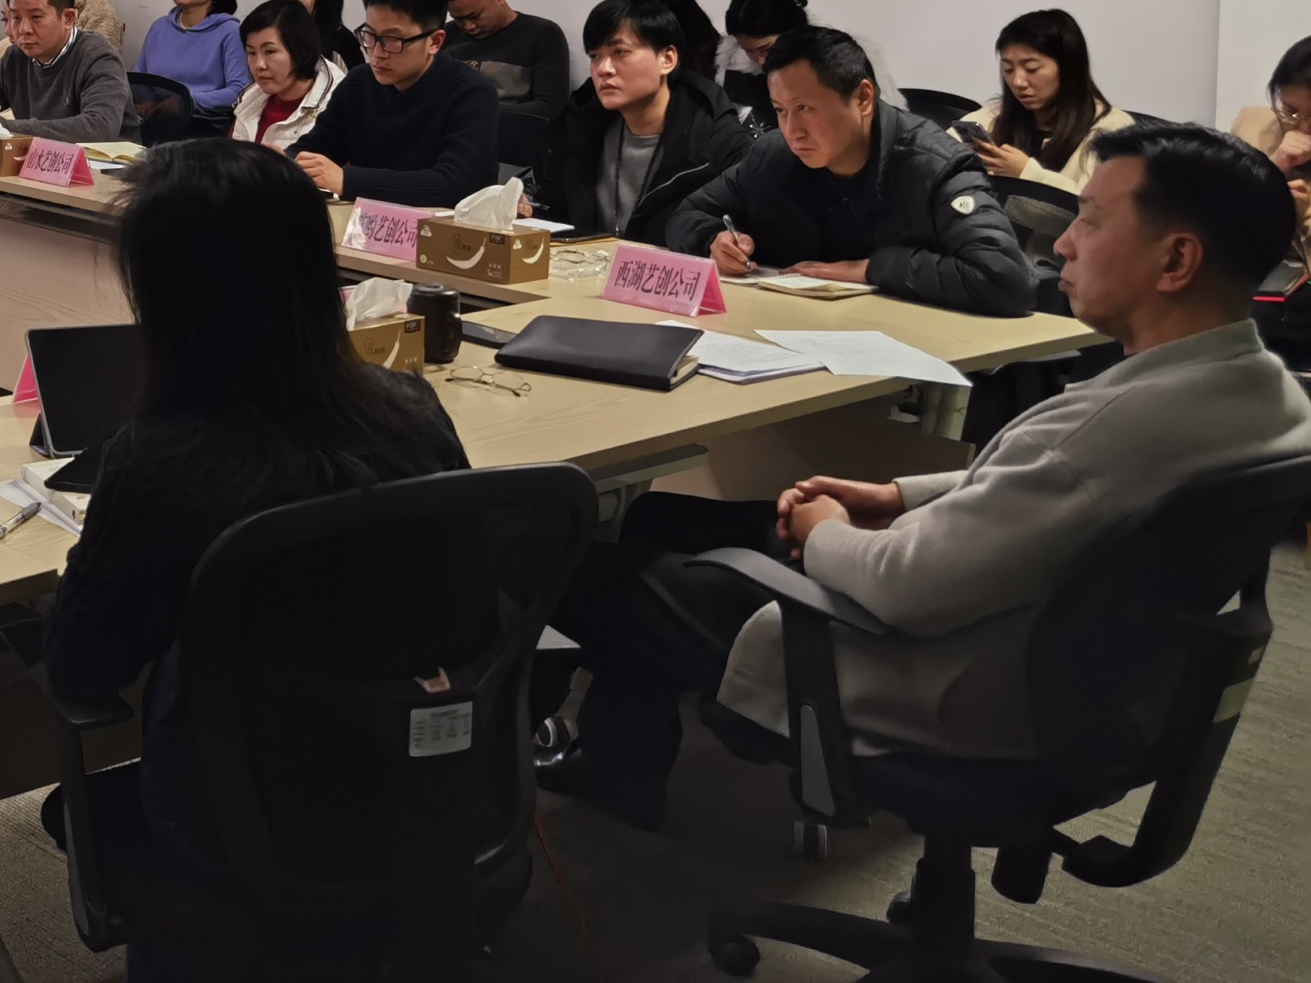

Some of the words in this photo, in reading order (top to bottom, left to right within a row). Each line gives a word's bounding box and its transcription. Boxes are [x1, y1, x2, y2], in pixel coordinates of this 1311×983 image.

[26, 148, 75, 175] 山水艺创公司
[614, 260, 701, 301] 西湖艺创公司
